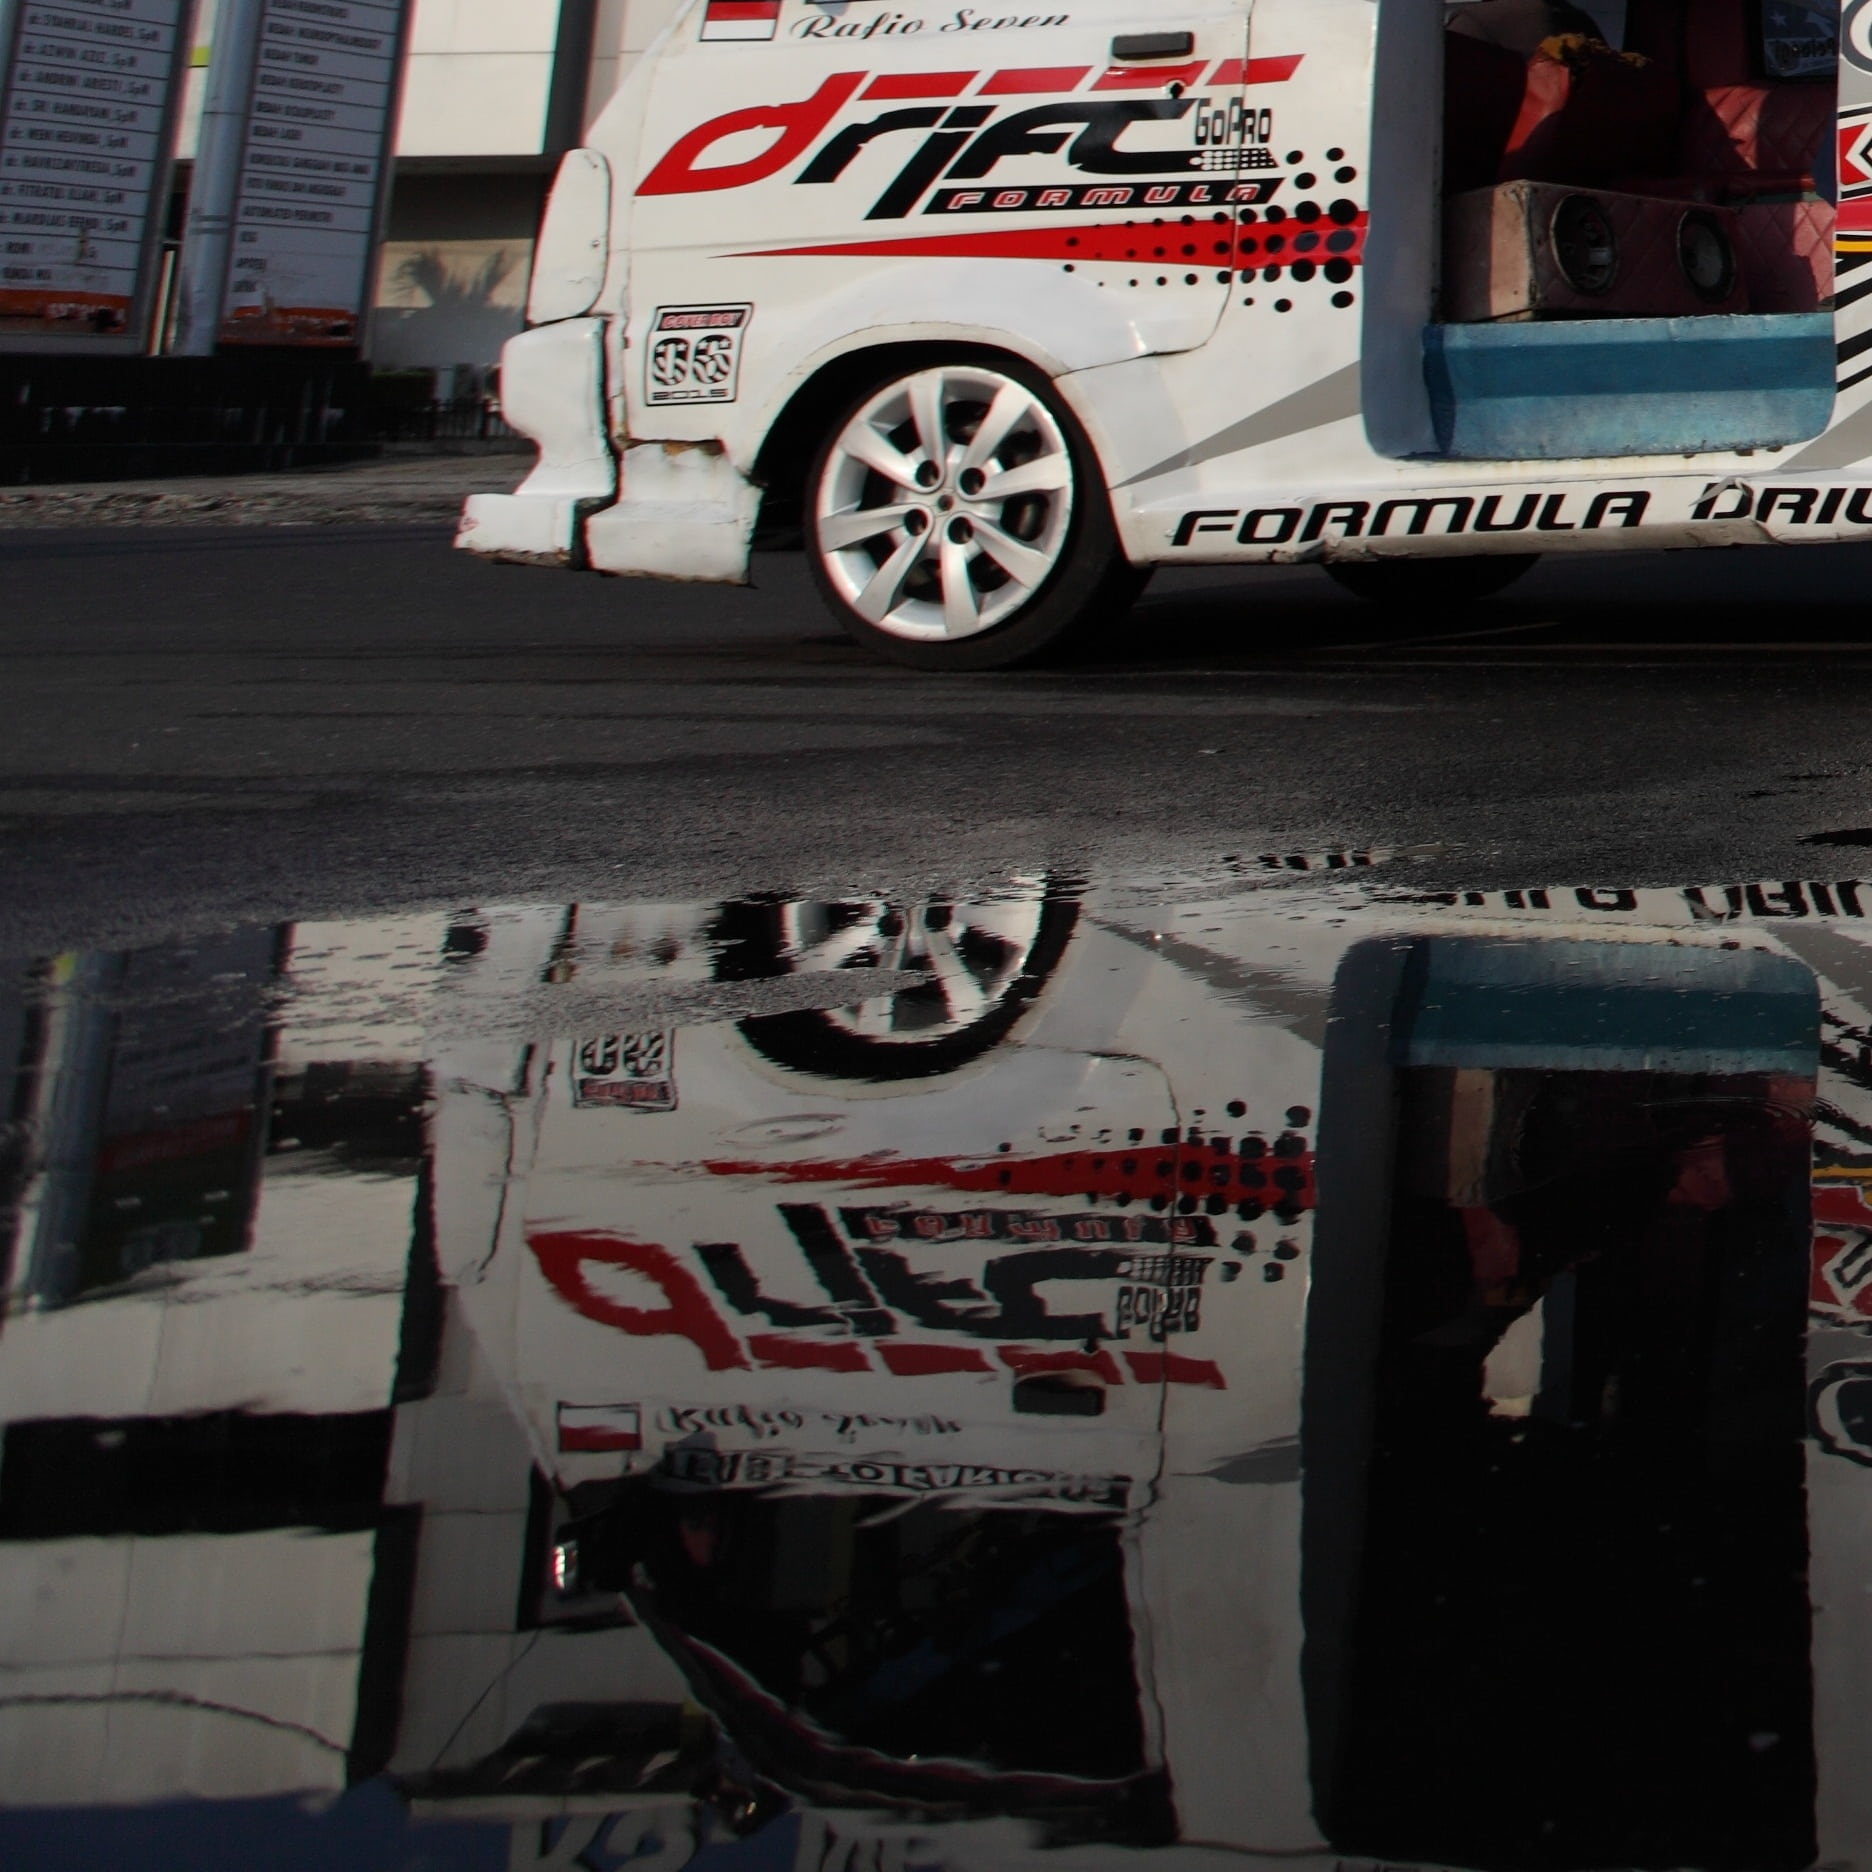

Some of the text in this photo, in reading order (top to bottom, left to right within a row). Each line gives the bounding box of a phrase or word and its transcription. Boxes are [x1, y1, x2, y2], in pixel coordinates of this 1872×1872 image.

[634, 69, 1204, 220] drift
[947, 183, 1258, 211] FORMULA
[1171, 489, 1648, 548] FORMULA
